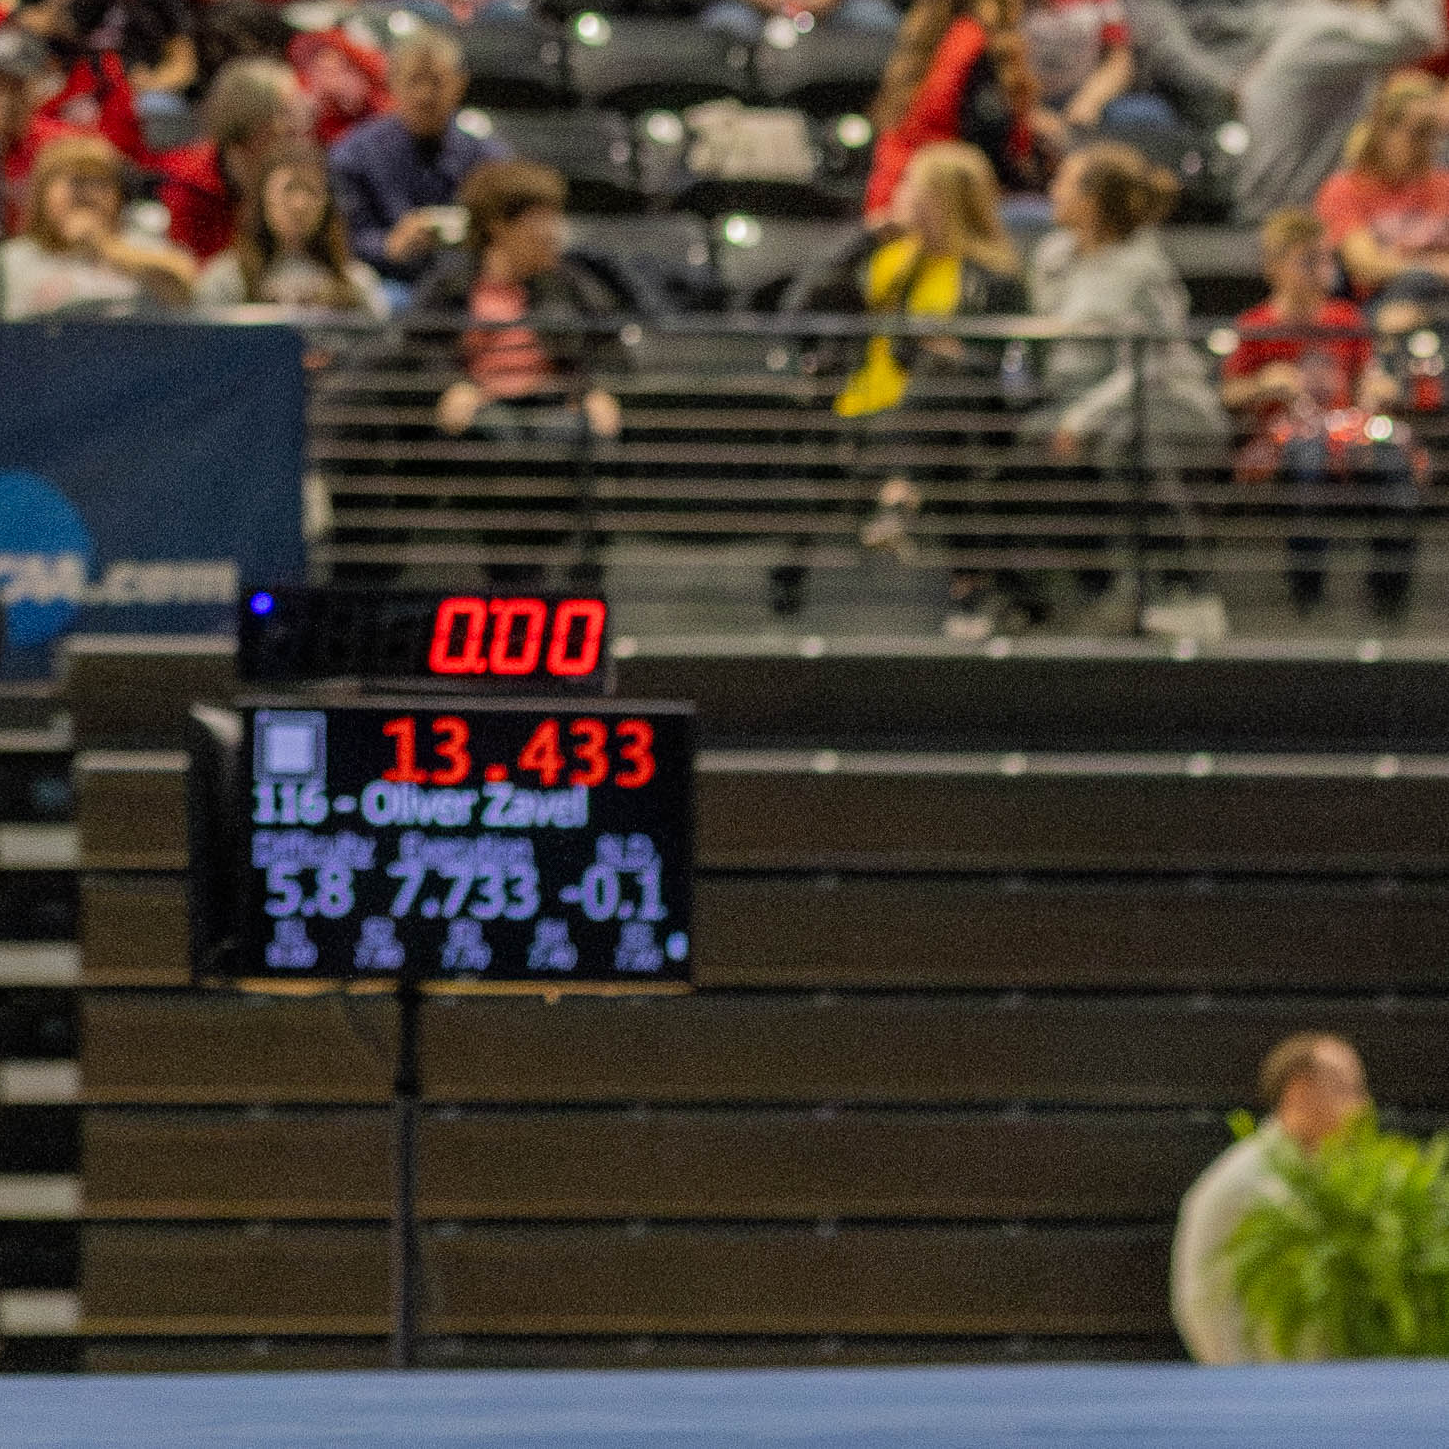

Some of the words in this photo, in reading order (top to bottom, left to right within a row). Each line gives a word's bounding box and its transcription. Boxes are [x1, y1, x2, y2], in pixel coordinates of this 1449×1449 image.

[381, 714, 657, 789] 13.433
[264, 862, 356, 917] 5.8
[385, 862, 541, 920] 7.733
[559, 862, 668, 921] -0.1
